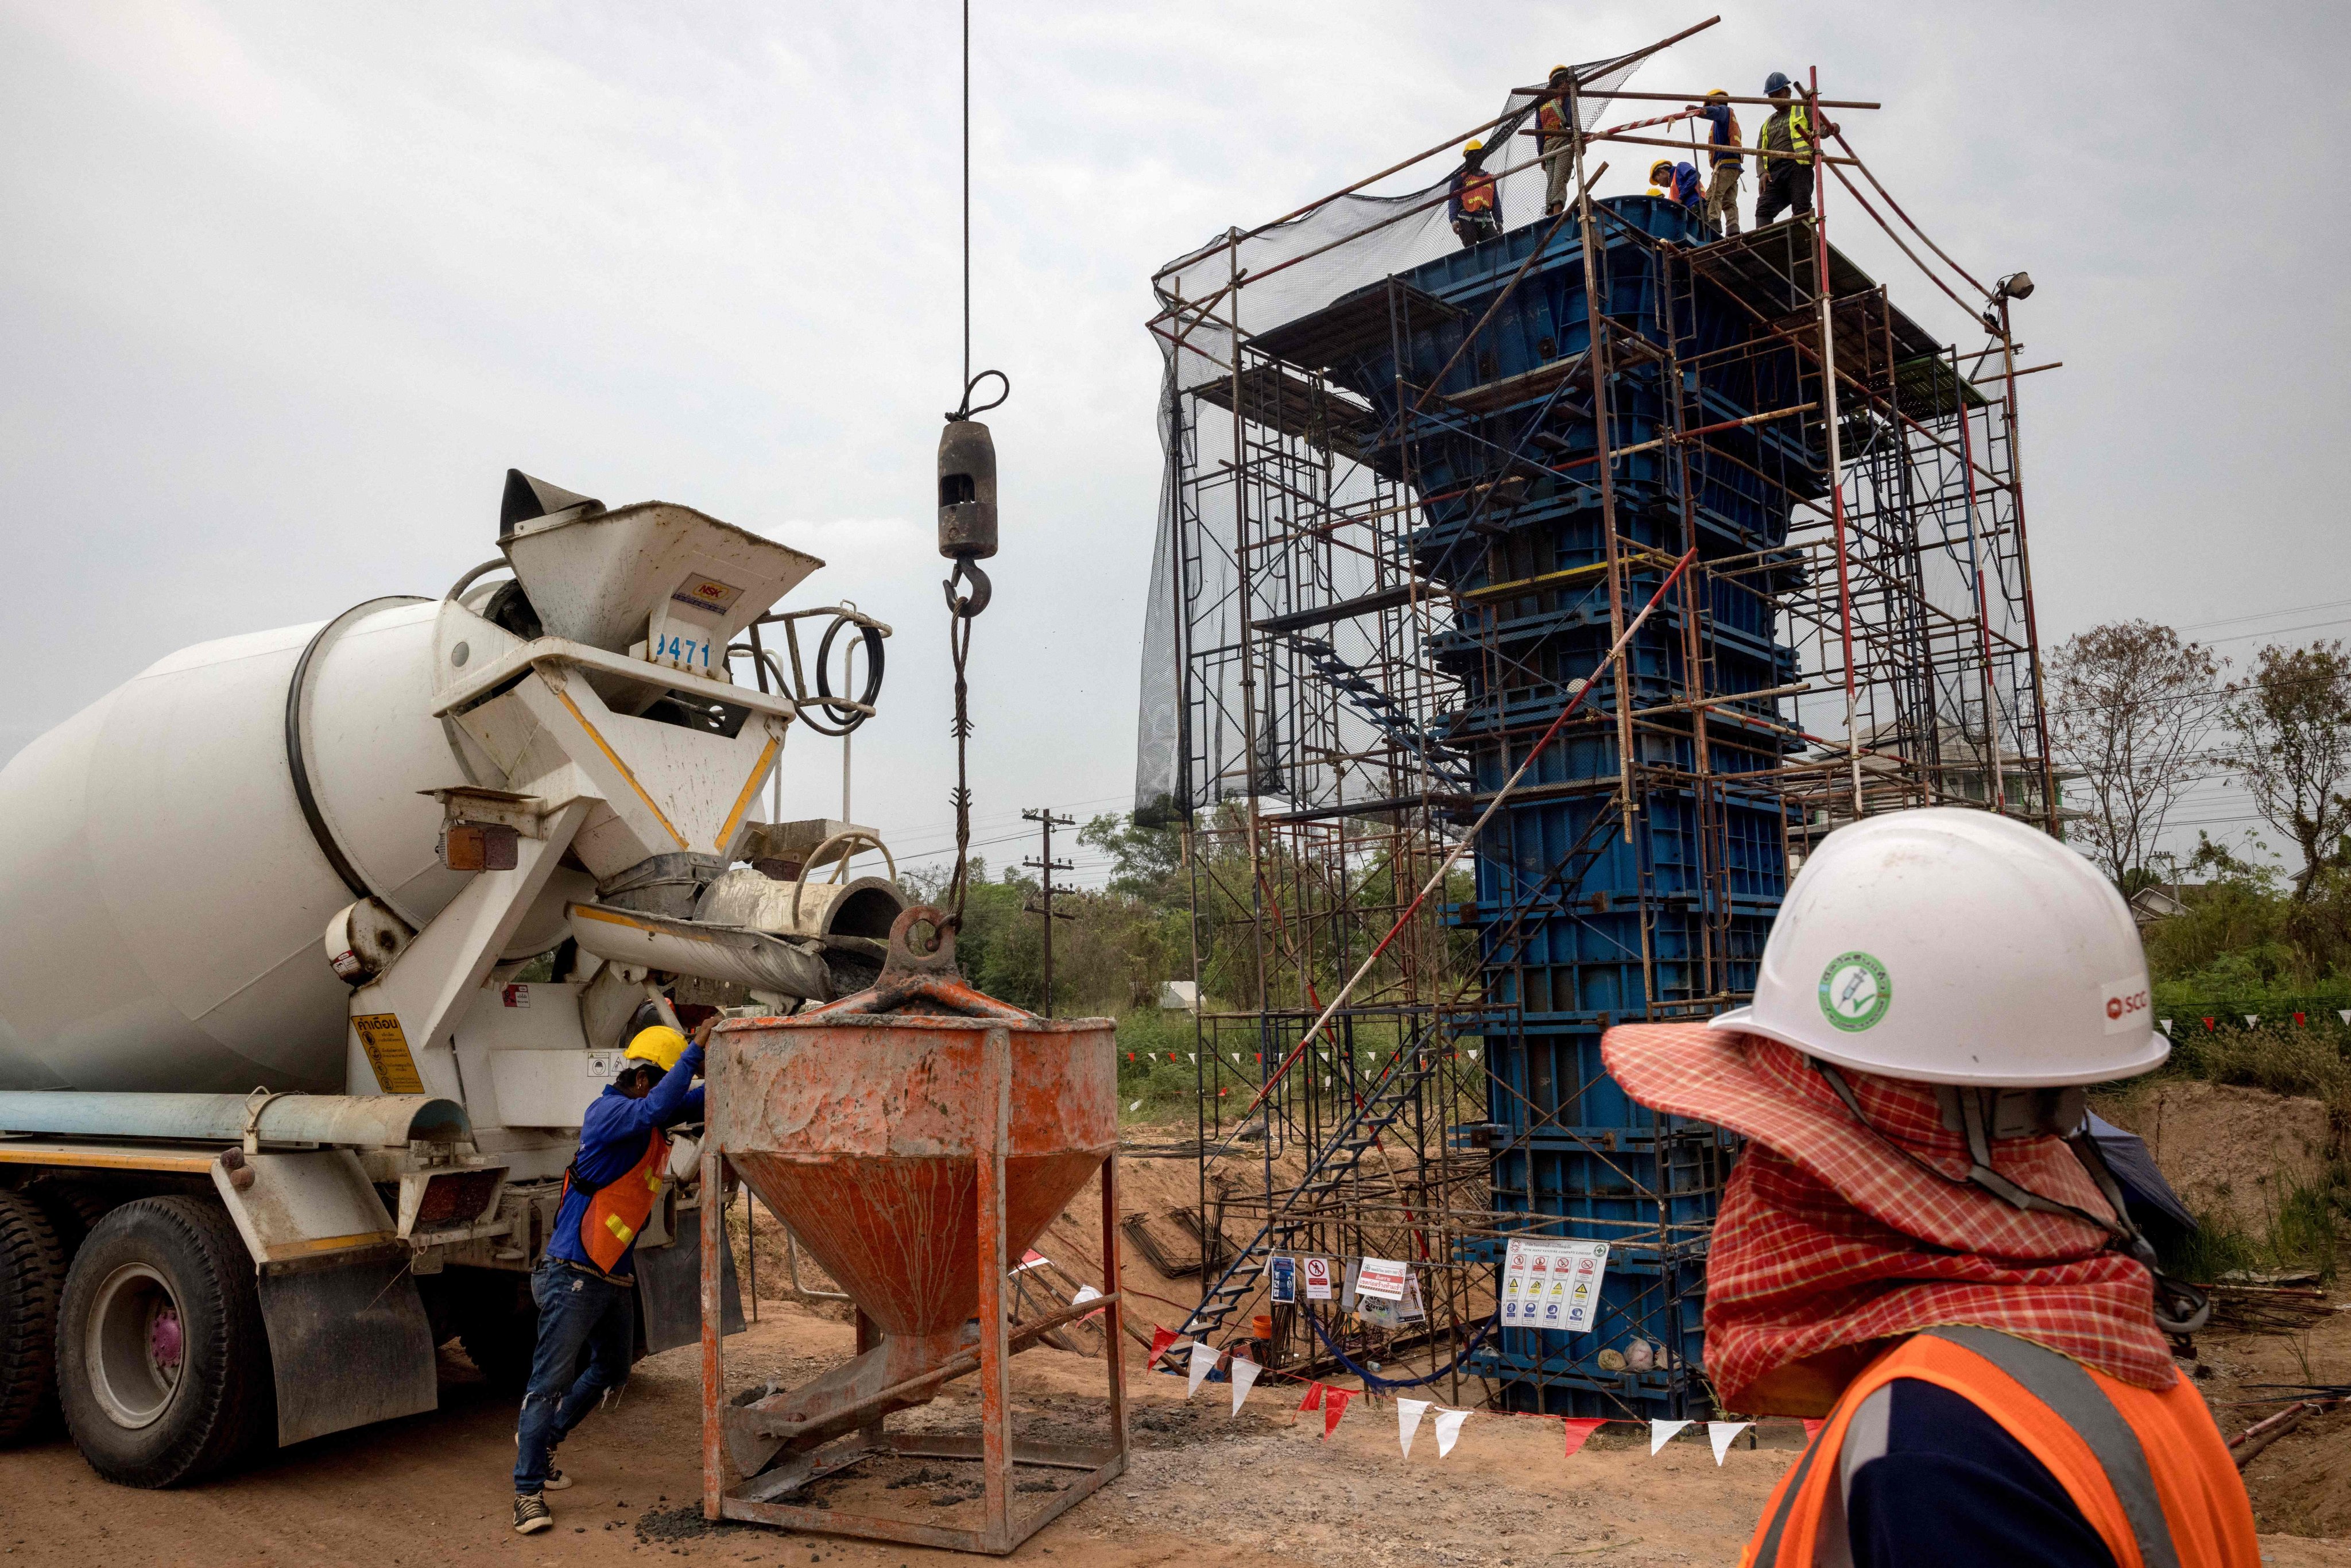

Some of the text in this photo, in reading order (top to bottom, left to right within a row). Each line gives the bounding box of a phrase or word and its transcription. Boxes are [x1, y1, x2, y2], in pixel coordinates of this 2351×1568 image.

[698, 584, 723, 598] NSK
[358, 1016, 398, 1031] คำเตือน
